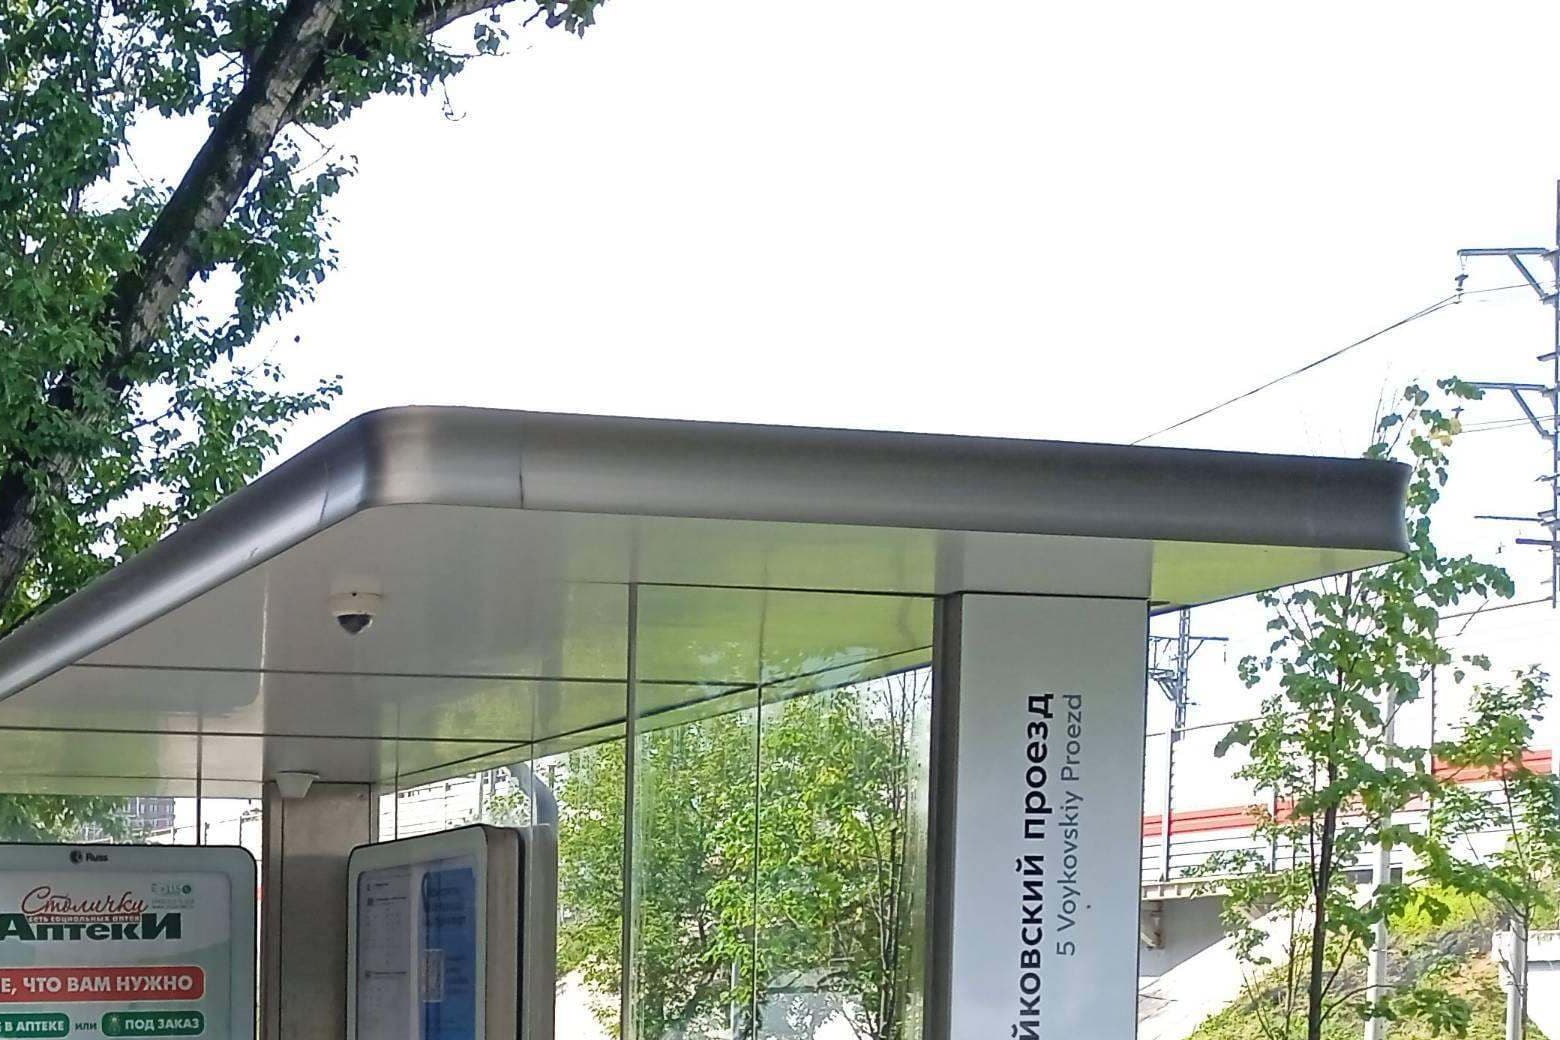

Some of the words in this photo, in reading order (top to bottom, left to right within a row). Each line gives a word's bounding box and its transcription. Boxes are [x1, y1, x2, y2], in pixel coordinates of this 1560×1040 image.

[1060, 693, 1084, 782] Proezd
[1023, 693, 1055, 839] проезд
[86, 853, 109, 862] Russ
[1057, 789, 1084, 932] Voykovskiy
[21, 886, 148, 915] Столички
[51, 915, 110, 923] социальных
[1056, 938, 1076, 956] 5
[23, 977, 62, 993] ЧТО
[67, 976, 111, 992] ВАМ
[116, 975, 193, 991] НУЖНО
[4, 1021, 13, 1032] В
[16, 1020, 65, 1032] АПТЕКЕ
[75, 1022, 97, 1031] или
[125, 1019, 155, 1031] ПОД
[157, 1017, 200, 1030] ЗАКАЗ
